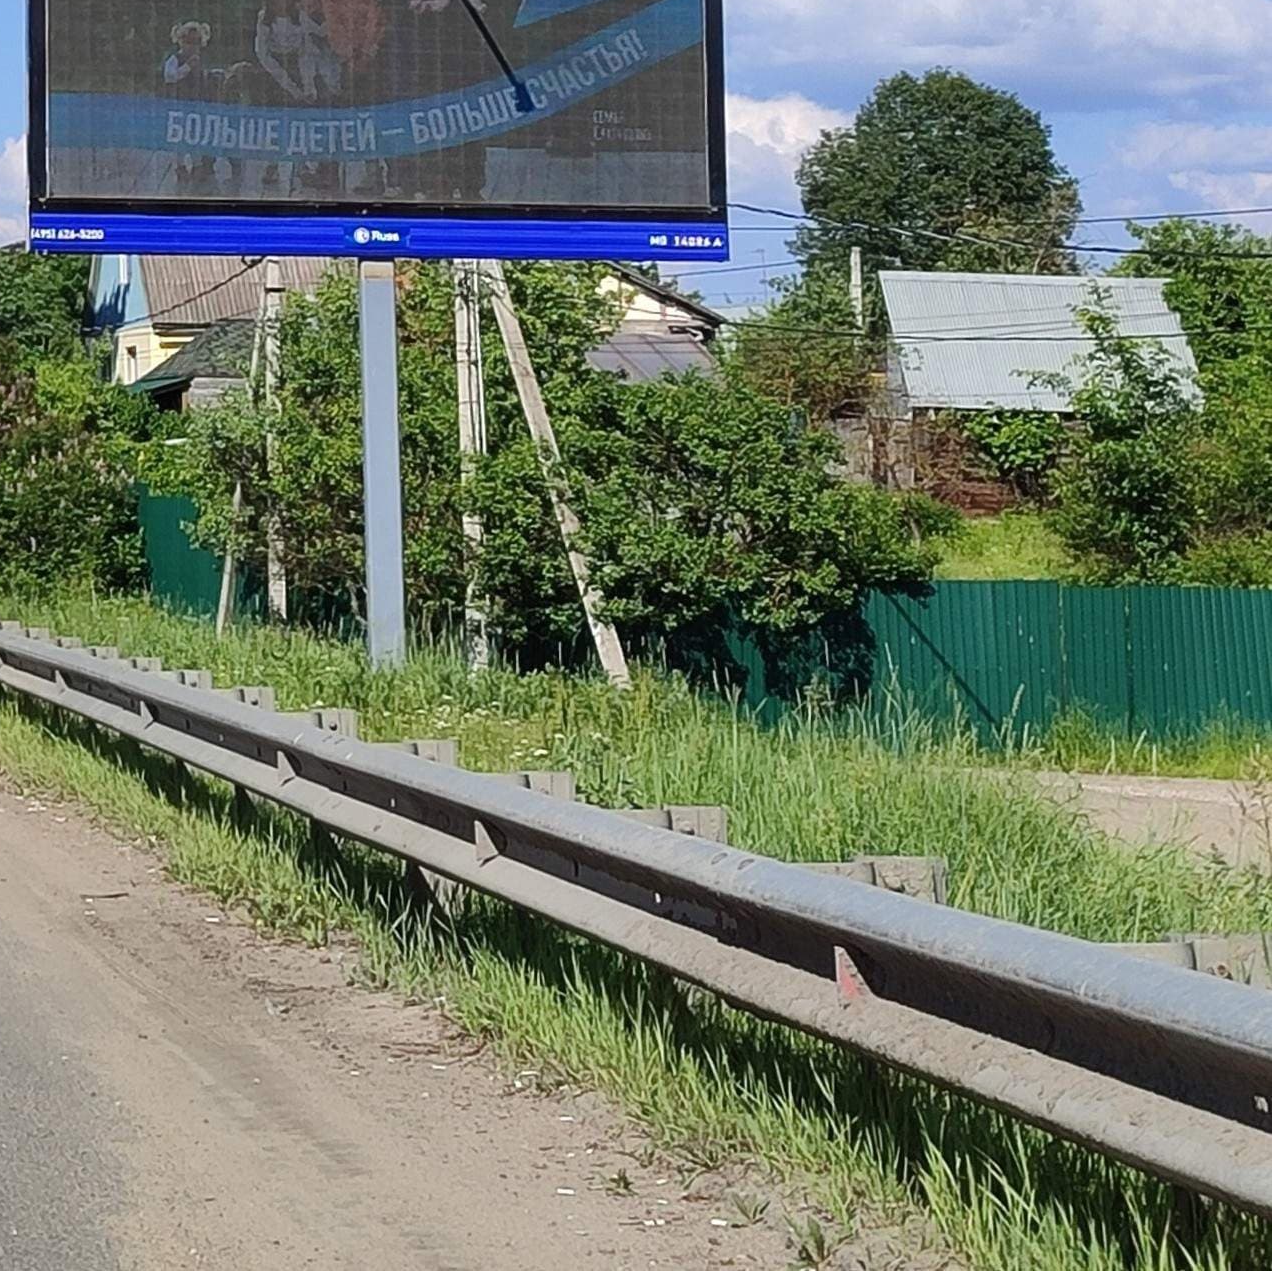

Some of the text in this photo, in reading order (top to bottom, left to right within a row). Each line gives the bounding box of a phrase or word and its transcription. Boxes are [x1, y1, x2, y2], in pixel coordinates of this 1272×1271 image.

[166, 110, 280, 151] БОЛЬШЕ
[286, 112, 377, 156] ДЕТЕЙ
[409, 86, 520, 145] БОЛЬШЕ
[524, 28, 650, 110] СЧАСТЬЯ!
